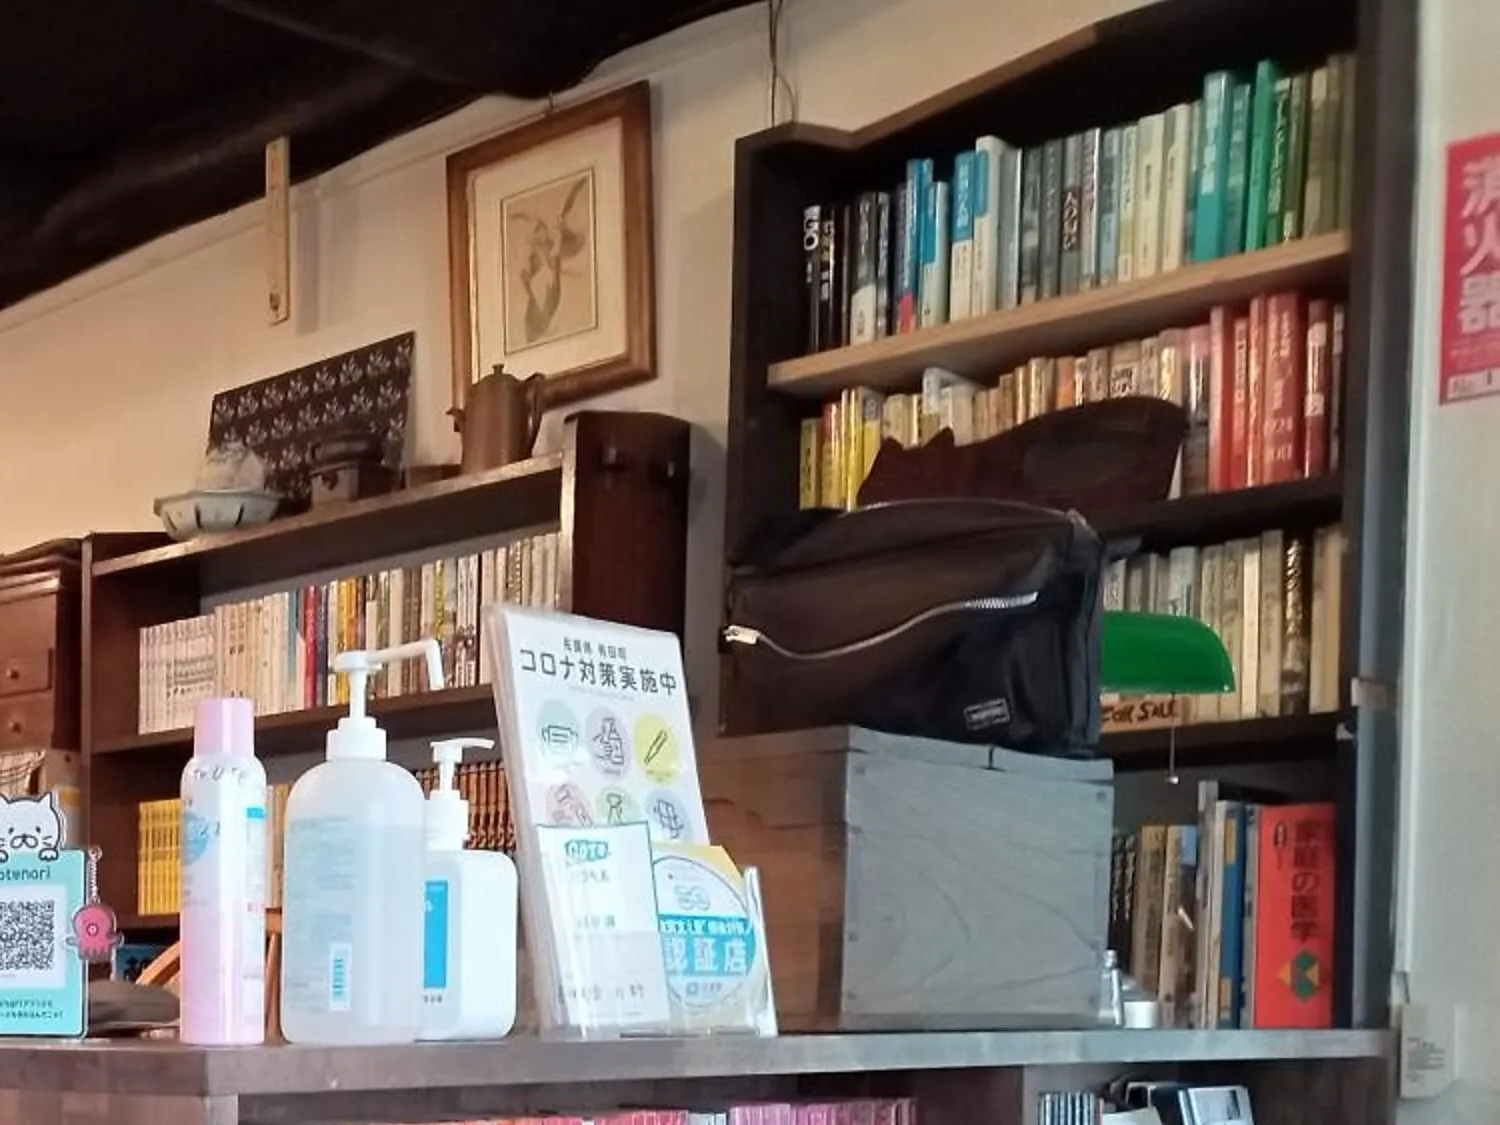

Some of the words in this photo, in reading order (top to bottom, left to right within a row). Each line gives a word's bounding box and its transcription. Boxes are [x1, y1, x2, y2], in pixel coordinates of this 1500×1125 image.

[519, 649, 678, 696] コロナ対策実施中
